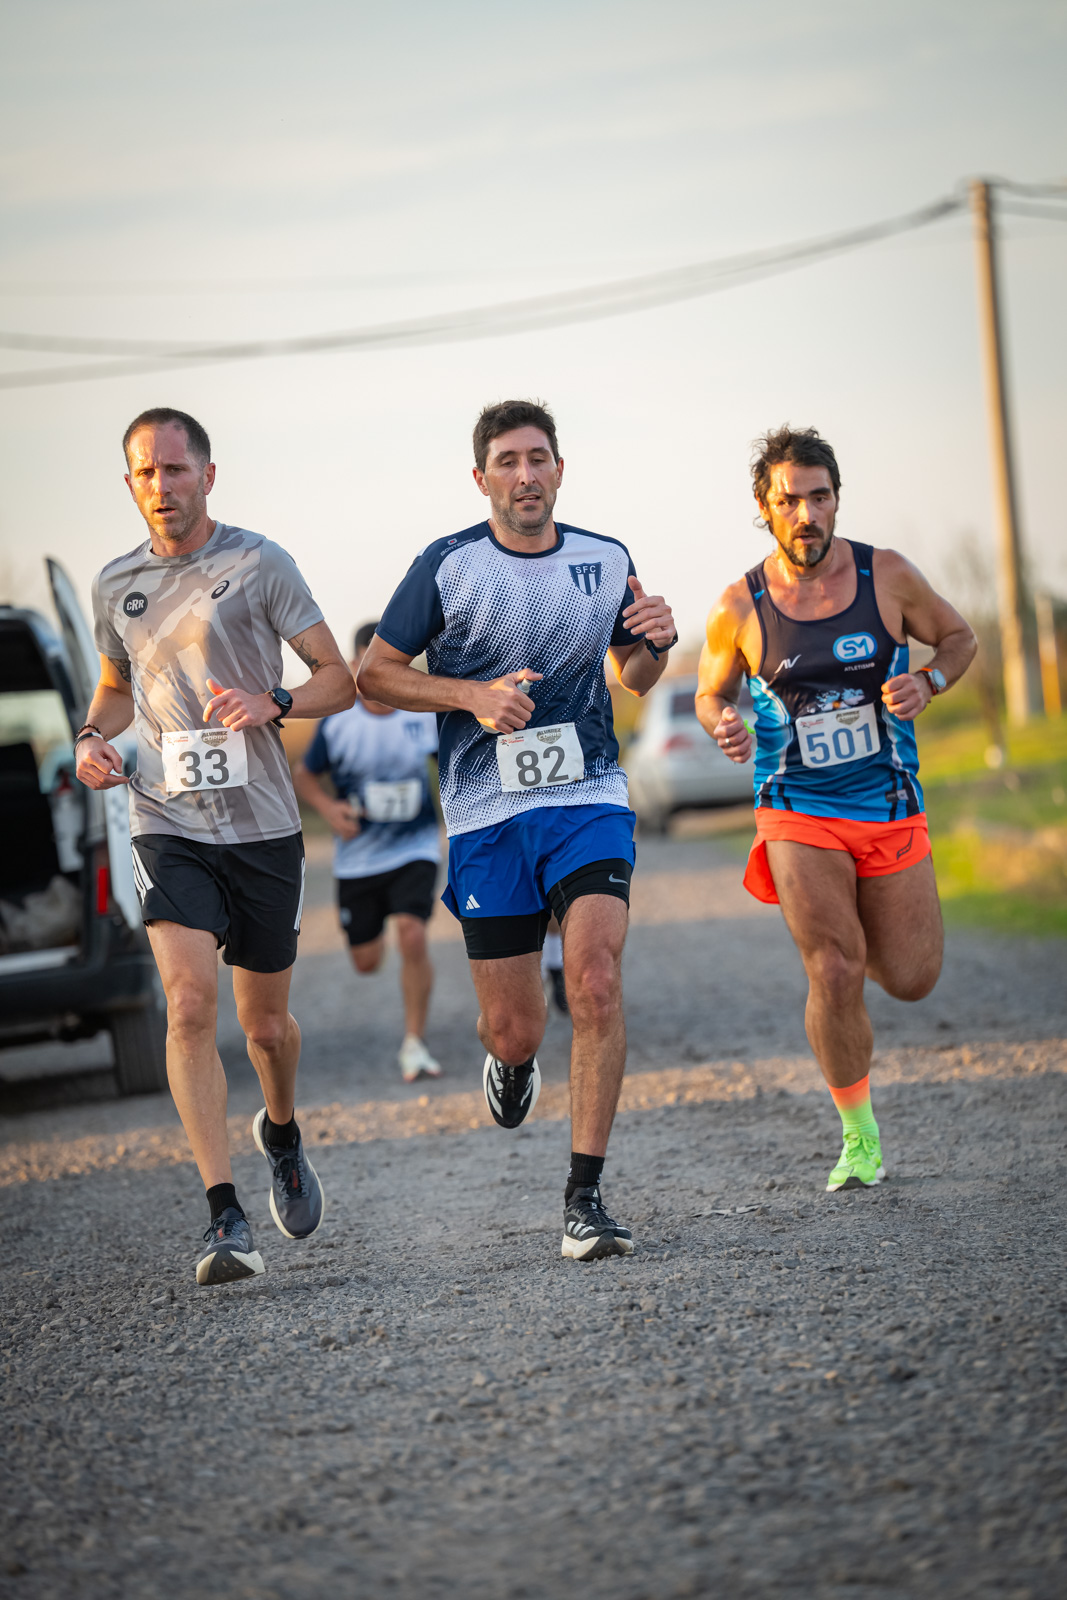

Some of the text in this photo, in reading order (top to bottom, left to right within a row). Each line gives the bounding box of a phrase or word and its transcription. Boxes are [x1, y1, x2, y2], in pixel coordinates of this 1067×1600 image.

[806, 722, 873, 765] 501
[178, 748, 230, 788] 33
[515, 745, 570, 787] 82
